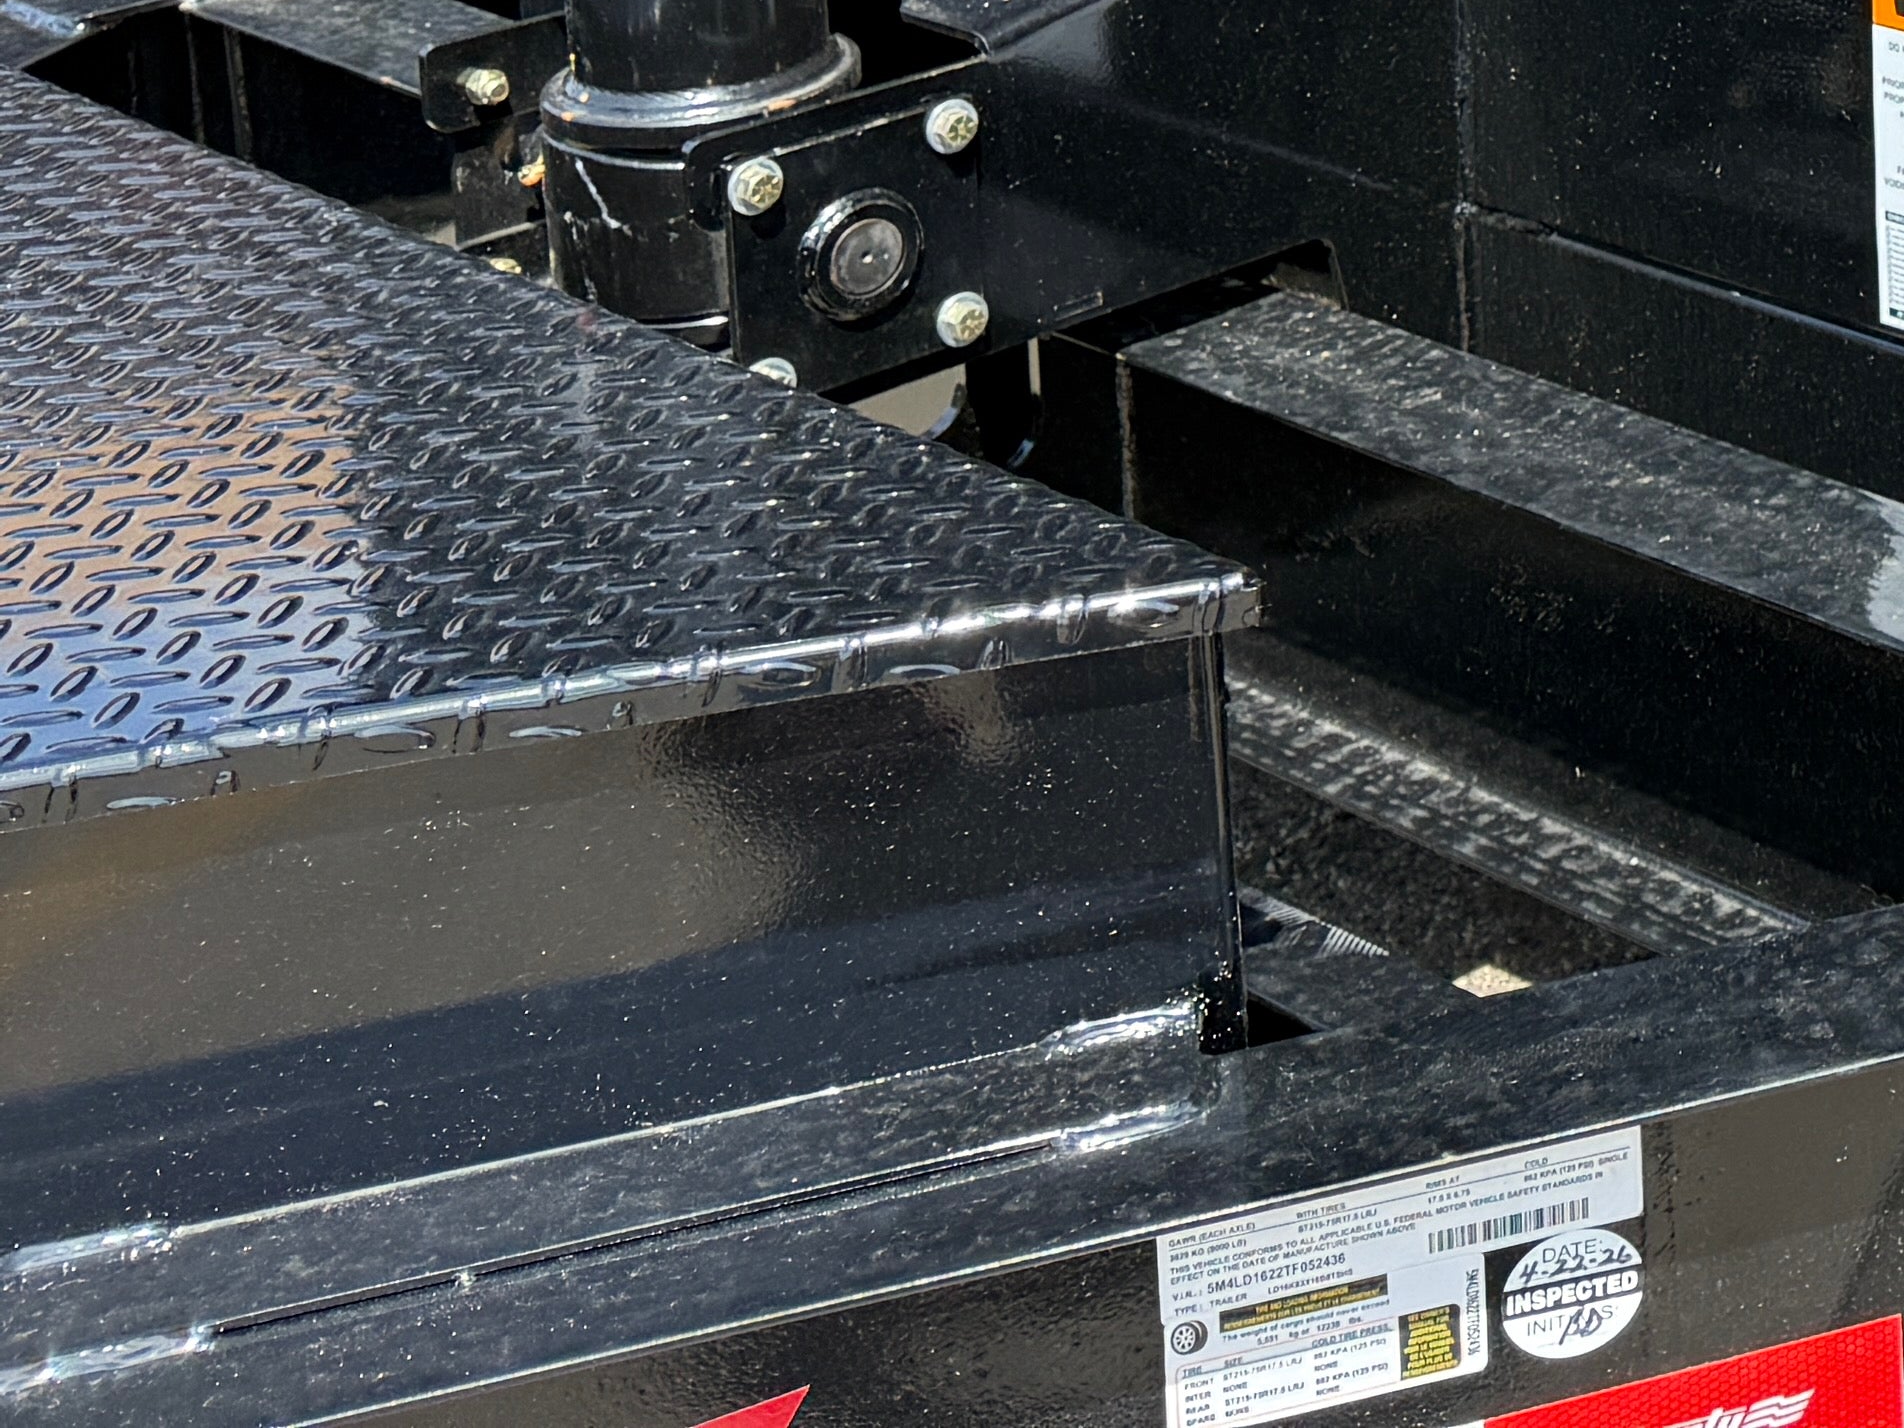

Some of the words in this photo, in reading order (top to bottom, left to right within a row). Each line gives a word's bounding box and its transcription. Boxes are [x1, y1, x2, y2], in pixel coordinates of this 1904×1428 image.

[1393, 1208, 1432, 1224] FEDERAL
[1542, 1238, 1603, 1264] DATE:
[1209, 1292, 1247, 1308] TRAILER
[1506, 1270, 1639, 1317] INSPECTED
